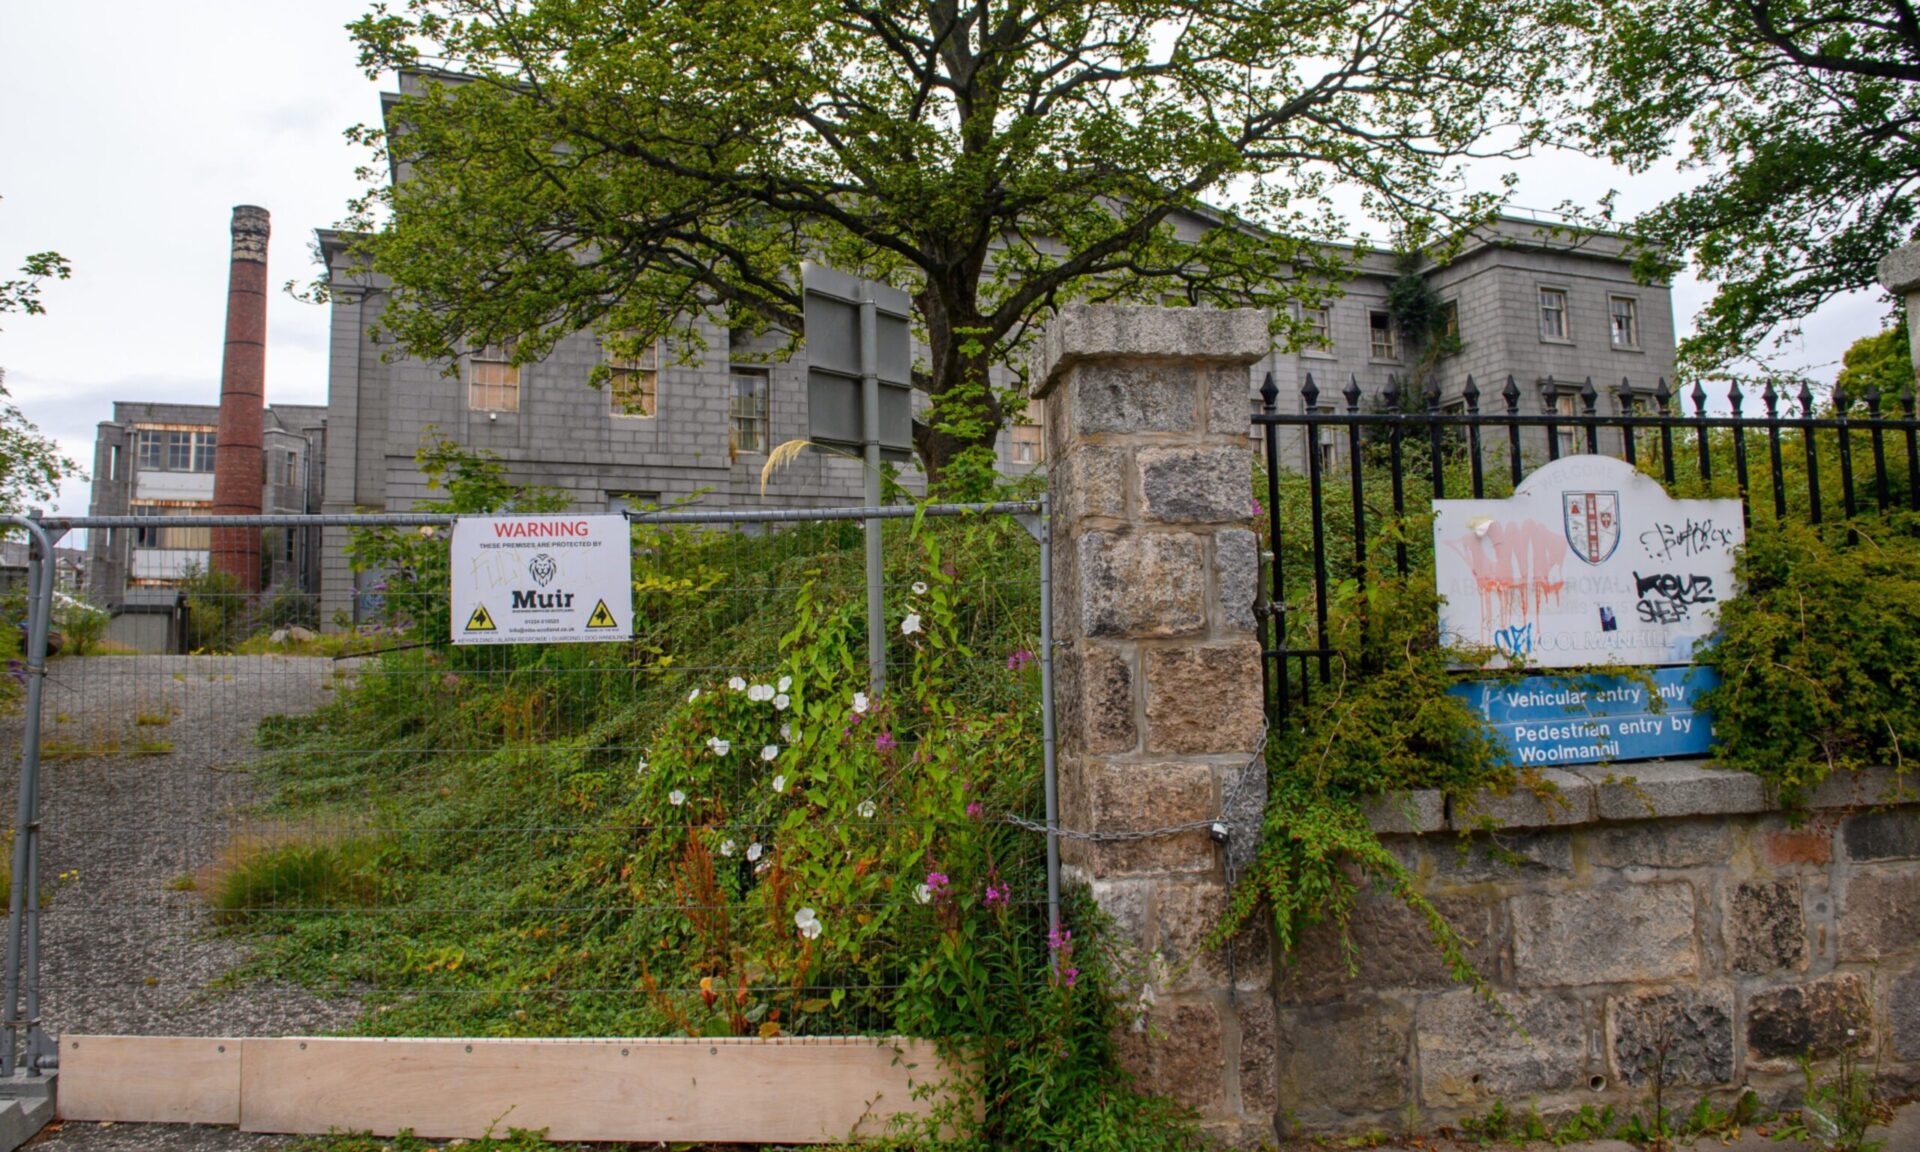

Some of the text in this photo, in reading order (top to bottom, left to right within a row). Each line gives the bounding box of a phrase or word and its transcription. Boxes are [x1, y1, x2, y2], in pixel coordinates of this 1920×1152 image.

[494, 521, 589, 538] WARNING
[1565, 576, 1626, 594] ROYAL
[512, 589, 574, 609] Muir
[1508, 690, 1588, 708] Vehicular
[1596, 686, 1641, 704] entry
[1515, 716, 1692, 742] Pedestrian entry by
